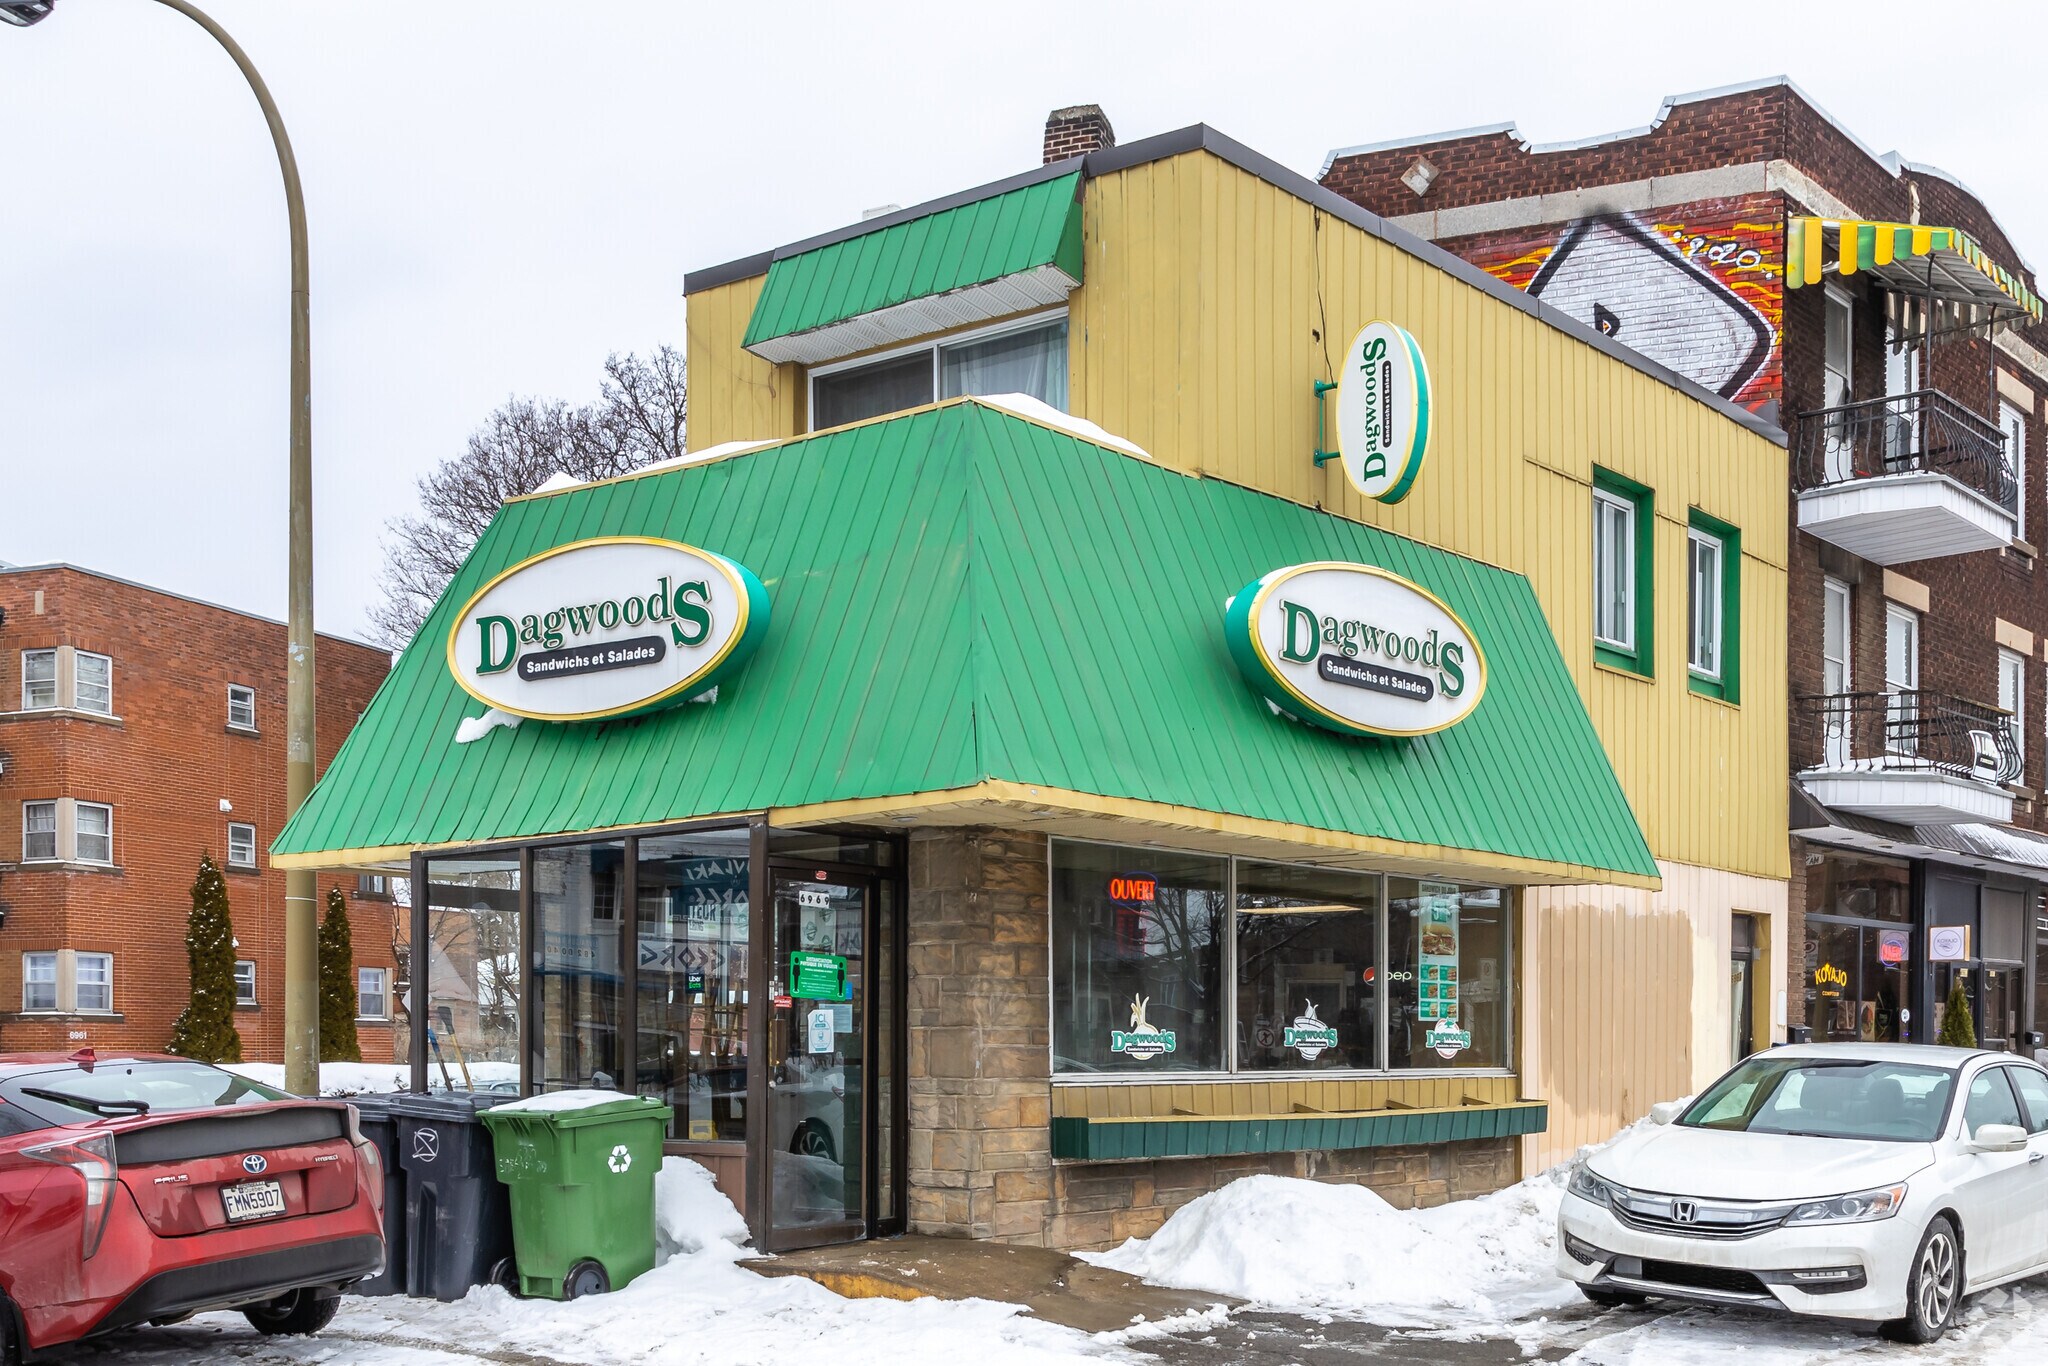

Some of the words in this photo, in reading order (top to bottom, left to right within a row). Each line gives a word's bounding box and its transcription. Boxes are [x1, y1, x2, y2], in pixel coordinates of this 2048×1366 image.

[476, 575, 712, 676] DagwoodS
[526, 654, 590, 674] Sandwichs
[591, 651, 605, 667] et
[607, 645, 656, 664] Salades
[1279, 599, 1465, 699] DagwoodS
[1326, 660, 1378, 684] Sandwichs
[1379, 675, 1389, 686] et
[1391, 676, 1427, 695] Salades
[800, 893, 830, 906] 6969
[1109, 878, 1156, 901] OUVERT
[1815, 963, 1847, 987] KOYAJO
[815, 1013, 826, 1022] ICI
[153, 1174, 189, 1184] PRIUS
[225, 1188, 279, 1213] FMN5907
